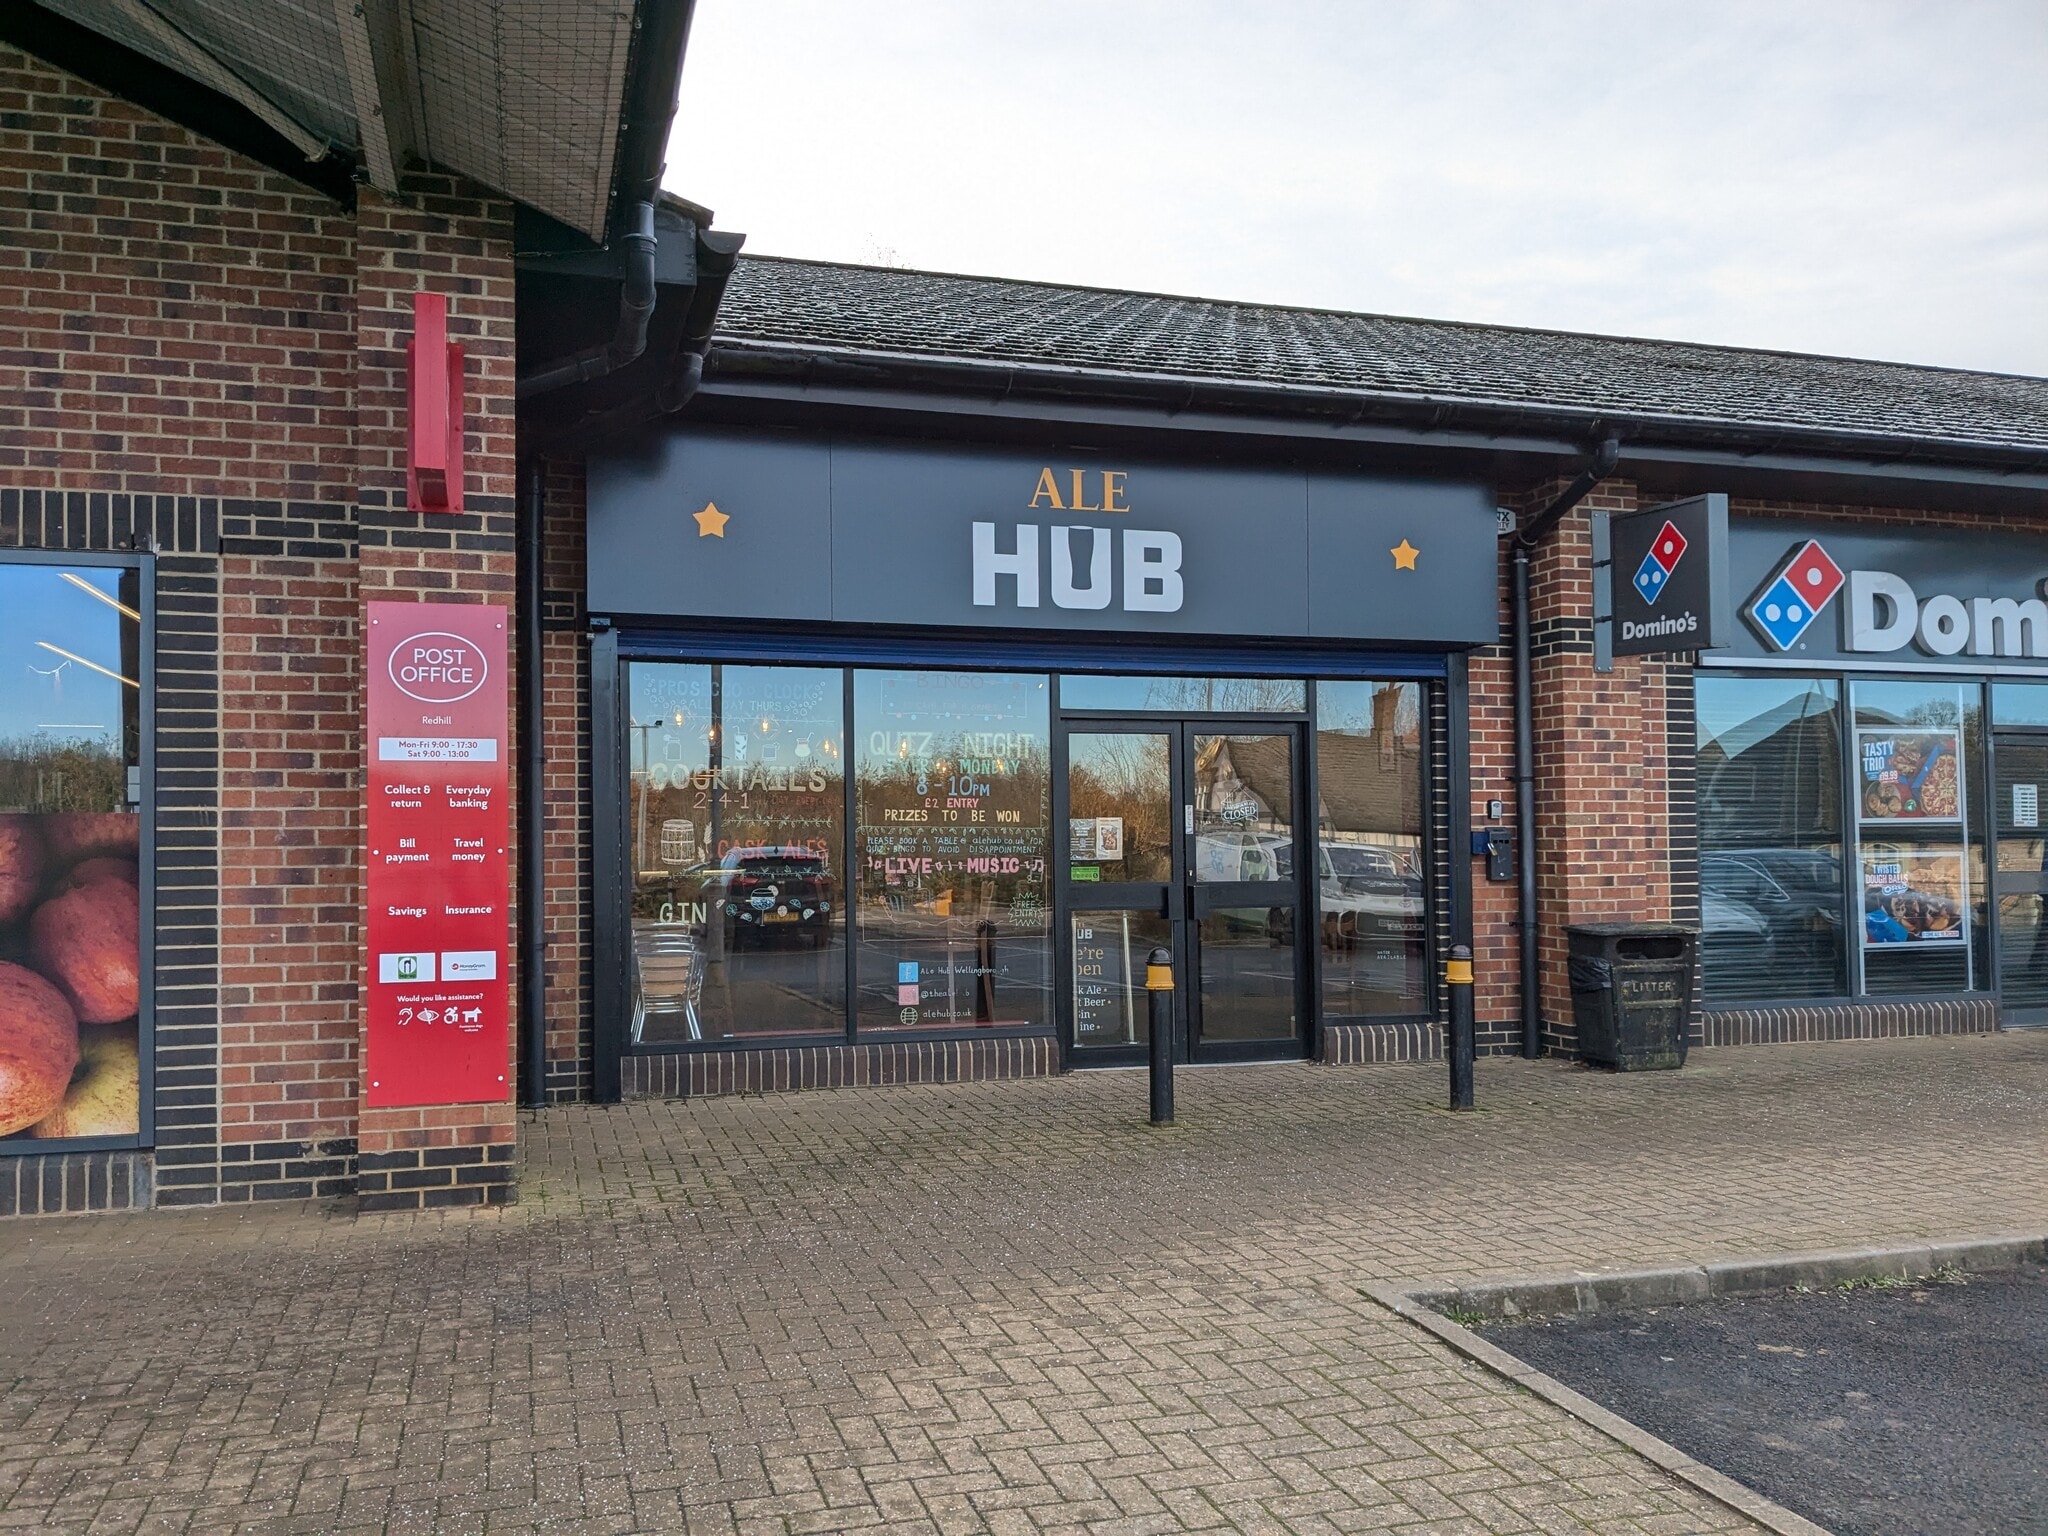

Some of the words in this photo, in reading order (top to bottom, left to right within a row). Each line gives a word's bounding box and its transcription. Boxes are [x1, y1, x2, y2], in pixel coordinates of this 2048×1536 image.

[1028, 467, 1130, 512] ALE
[973, 521, 1183, 612] HUB
[1845, 570, 2048, 657] Dom
[1622, 610, 1698, 640] Domino's
[413, 648, 466, 665] POST
[400, 665, 474, 683] OFFICE
[917, 673, 984, 689] BINGO
[749, 700, 782, 712] THURS
[422, 716, 452, 725] Redhill
[398, 740, 430, 749] Mon-Fri
[431, 741, 450, 749] 9:00
[457, 741, 478, 749] 17:30
[870, 731, 933, 757] QUIZ
[964, 733, 1034, 758] NIGHT
[1864, 740, 1894, 757] TASTY
[408, 750, 421, 758] Sat
[423, 750, 441, 758] 9:00
[448, 750, 469, 758] 13:00
[959, 759, 1020, 775] MONDAY
[1862, 756, 1885, 772] TRIO
[650, 762, 827, 792] COCKTAILS
[384, 784, 422, 794] Collect
[423, 785, 431, 794] &
[446, 785, 491, 797] Everyday
[916, 776, 928, 795] 8
[948, 776, 990, 796] 10PM
[391, 800, 422, 808] return
[449, 798, 488, 810] banking
[924, 798, 939, 808] £2
[946, 798, 979, 808] ENTRY
[884, 809, 928, 822] PRIZES
[942, 810, 958, 822] TO
[971, 810, 986, 822] BE
[996, 810, 1020, 822] WON
[1223, 806, 1256, 820] CLOSED
[399, 838, 416, 848] Bill
[454, 838, 483, 848] Travel
[867, 836, 894, 845] PLEASE
[899, 837, 918, 845] BOOK
[934, 836, 958, 845] TABLE
[972, 836, 1025, 845] alehub.co.uk
[717, 839, 769, 860] CASK
[783, 838, 828, 860] ALES
[893, 845, 916, 853] BINGO
[386, 852, 430, 864] payment
[452, 853, 486, 863] money
[885, 857, 932, 874] LIVE
[967, 857, 1020, 874] MUSIC
[1872, 863, 1902, 874] TWISTED
[1865, 874, 1886, 884] DOUGH
[1888, 873, 1909, 884] BALLS
[1882, 884, 1909, 895] OREO
[445, 905, 492, 915] Insurance
[1017, 900, 1036, 909] FREE
[388, 906, 427, 918] Savings
[659, 902, 707, 924] GIN
[1015, 909, 1038, 918] ENTRY
[1076, 928, 1093, 939] UB
[1077, 946, 1104, 960] e're
[938, 967, 951, 975] Hub
[954, 965, 1009, 977] Wellingborogh
[1086, 985, 1102, 995] Ale
[1632, 981, 1672, 992] LITTER
[397, 994, 420, 1003] Would
[421, 995, 434, 1003] you
[447, 993, 484, 1001] assistance?
[1084, 997, 1106, 1007] Beer
[922, 1008, 972, 1018] alehub.co.uk
